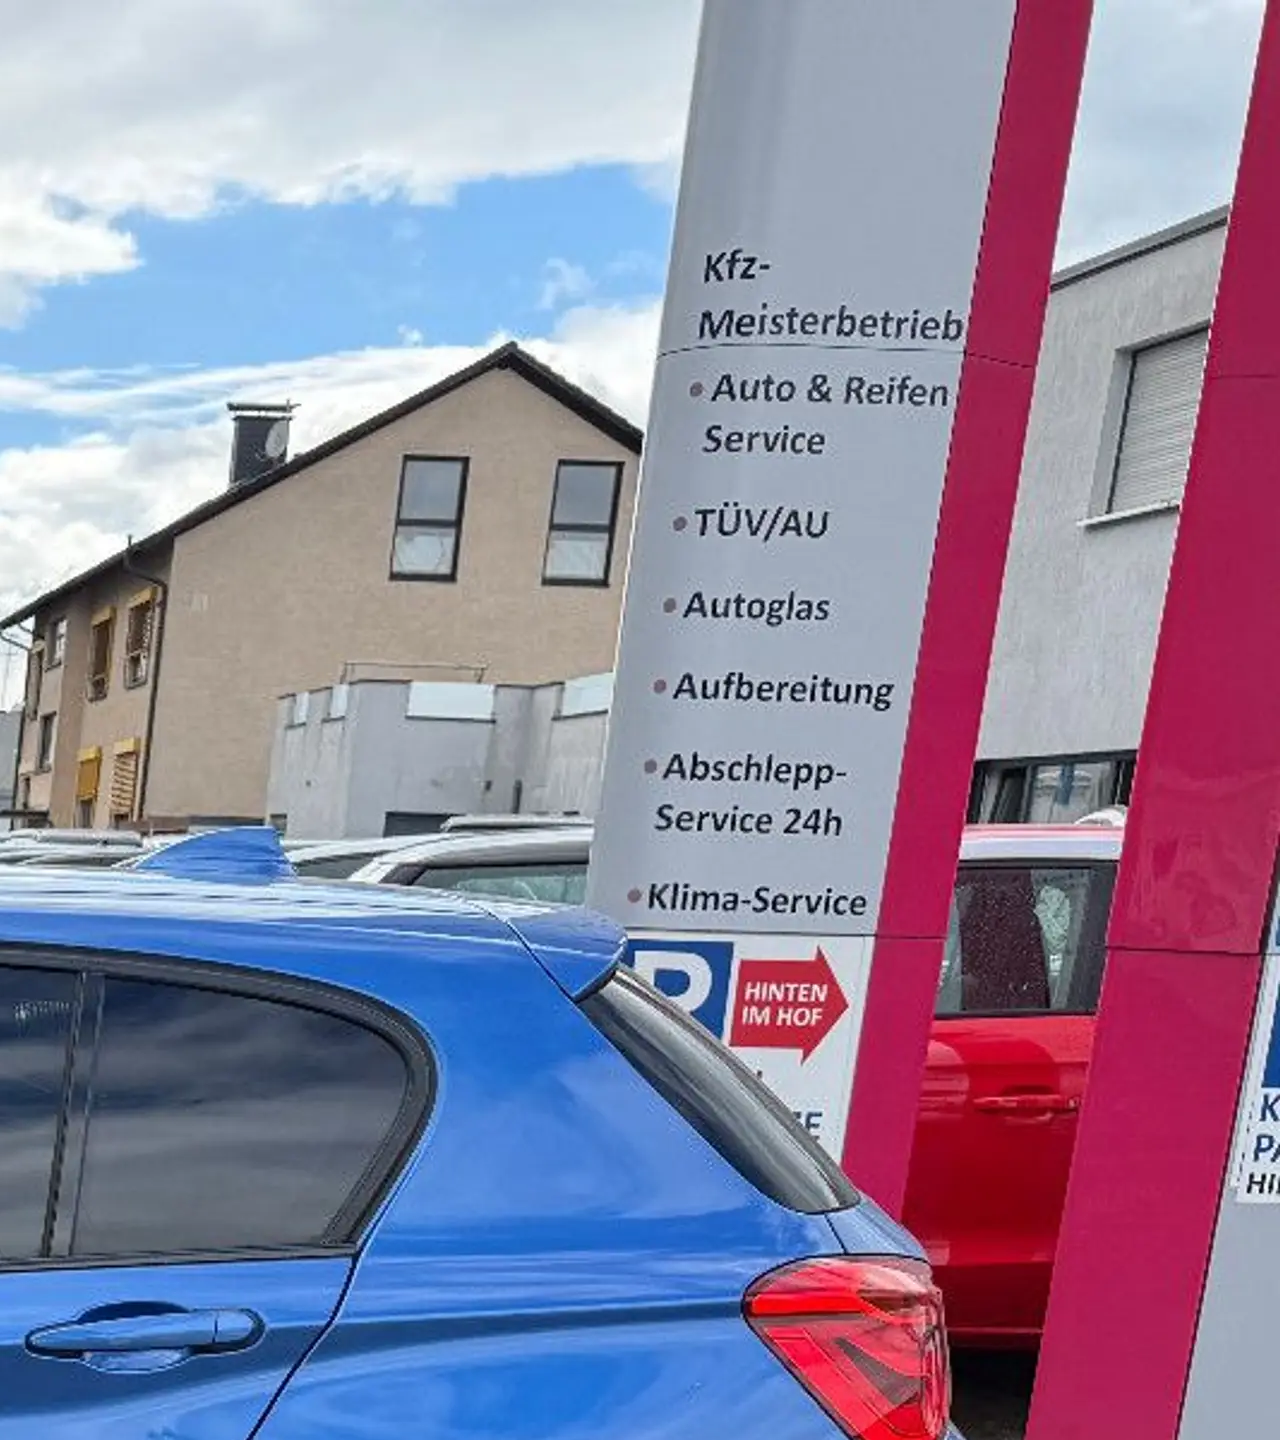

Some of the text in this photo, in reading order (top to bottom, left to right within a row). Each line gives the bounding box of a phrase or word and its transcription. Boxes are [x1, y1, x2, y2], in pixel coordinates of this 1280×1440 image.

[703, 248, 771, 285] Kfz-
[697, 303, 964, 342] Meisterbetrieb
[710, 373, 949, 407] Auto & Reifen
[701, 424, 826, 455] Service
[694, 501, 830, 543] TÜV/AU
[682, 590, 831, 628] Autoglas
[671, 671, 896, 712] Aufbereitung
[661, 752, 847, 791] Abschlepp-
[653, 803, 843, 837] Service 24h
[647, 881, 868, 917] Klima-Service
[744, 982, 828, 1003] HINTEN
[741, 1005, 823, 1027] IM HOF
